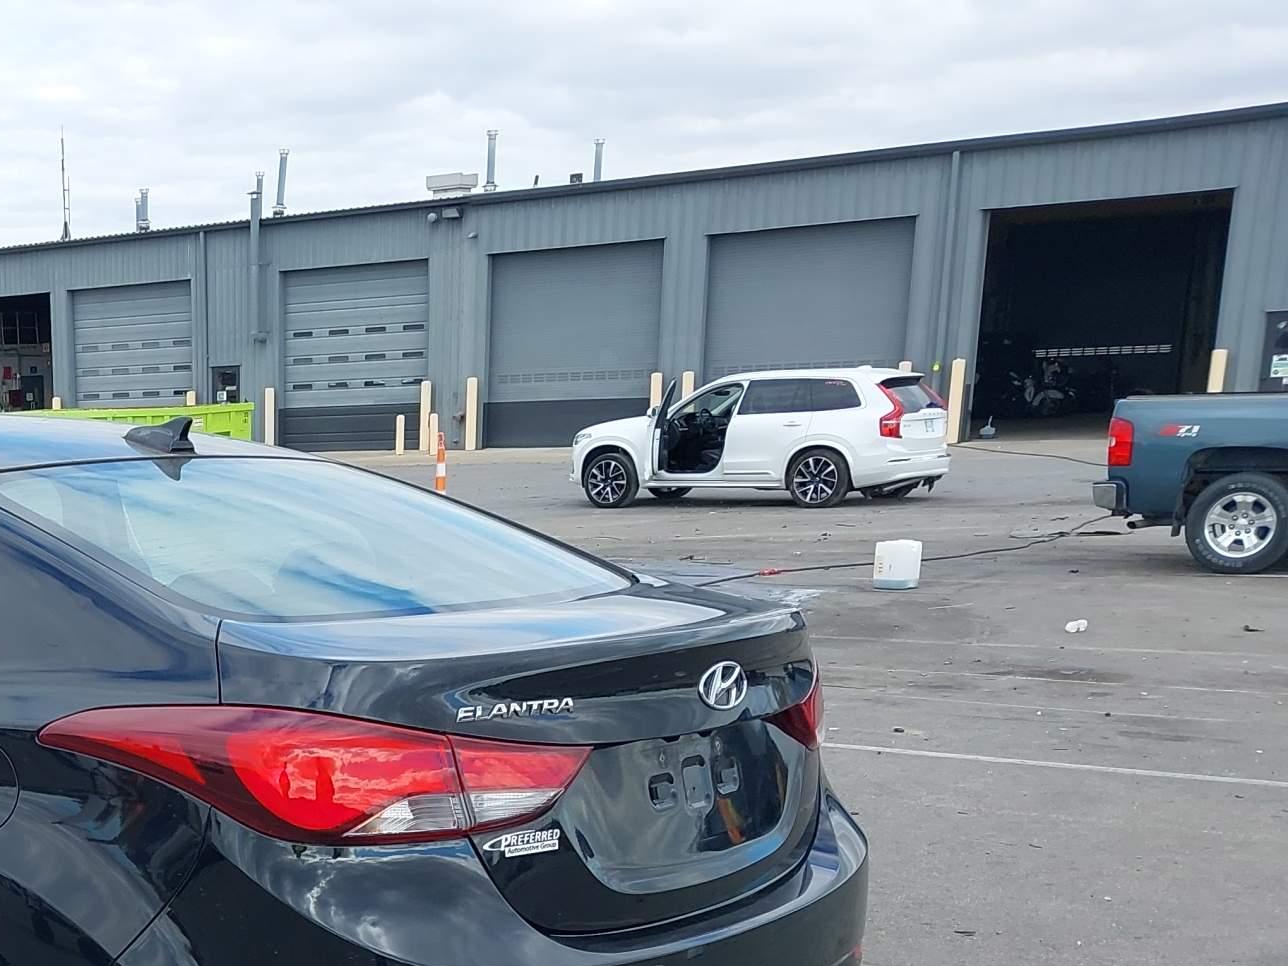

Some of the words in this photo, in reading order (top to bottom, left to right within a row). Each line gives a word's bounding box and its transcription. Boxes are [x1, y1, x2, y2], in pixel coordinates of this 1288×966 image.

[456, 697, 574, 723] ELANTRA
[495, 829, 561, 850] PREFERRED
[507, 845, 539, 855] Automotive
